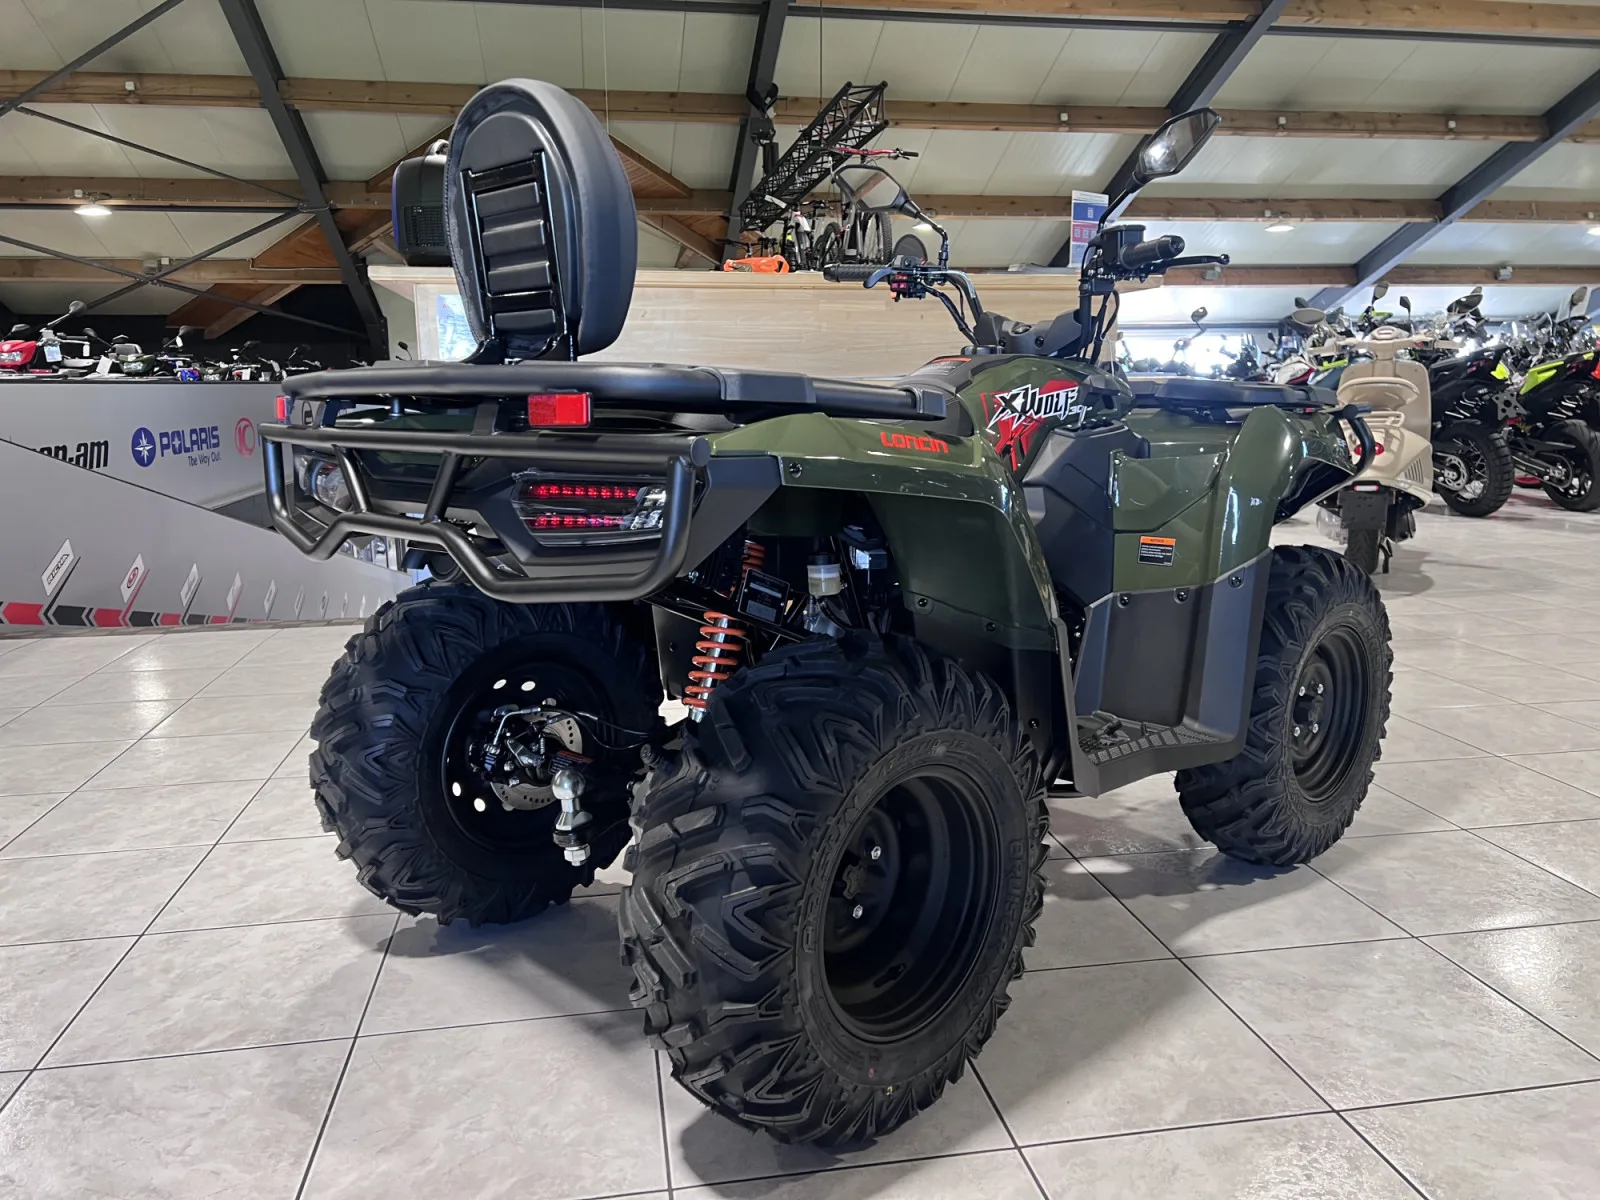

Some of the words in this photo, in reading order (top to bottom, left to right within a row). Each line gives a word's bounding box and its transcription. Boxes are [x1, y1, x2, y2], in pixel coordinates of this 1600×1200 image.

[159, 426, 220, 457] POLARIS
[880, 431, 949, 453] LONCIN
[188, 456, 198, 467] The
[199, 455, 210, 467] Way
